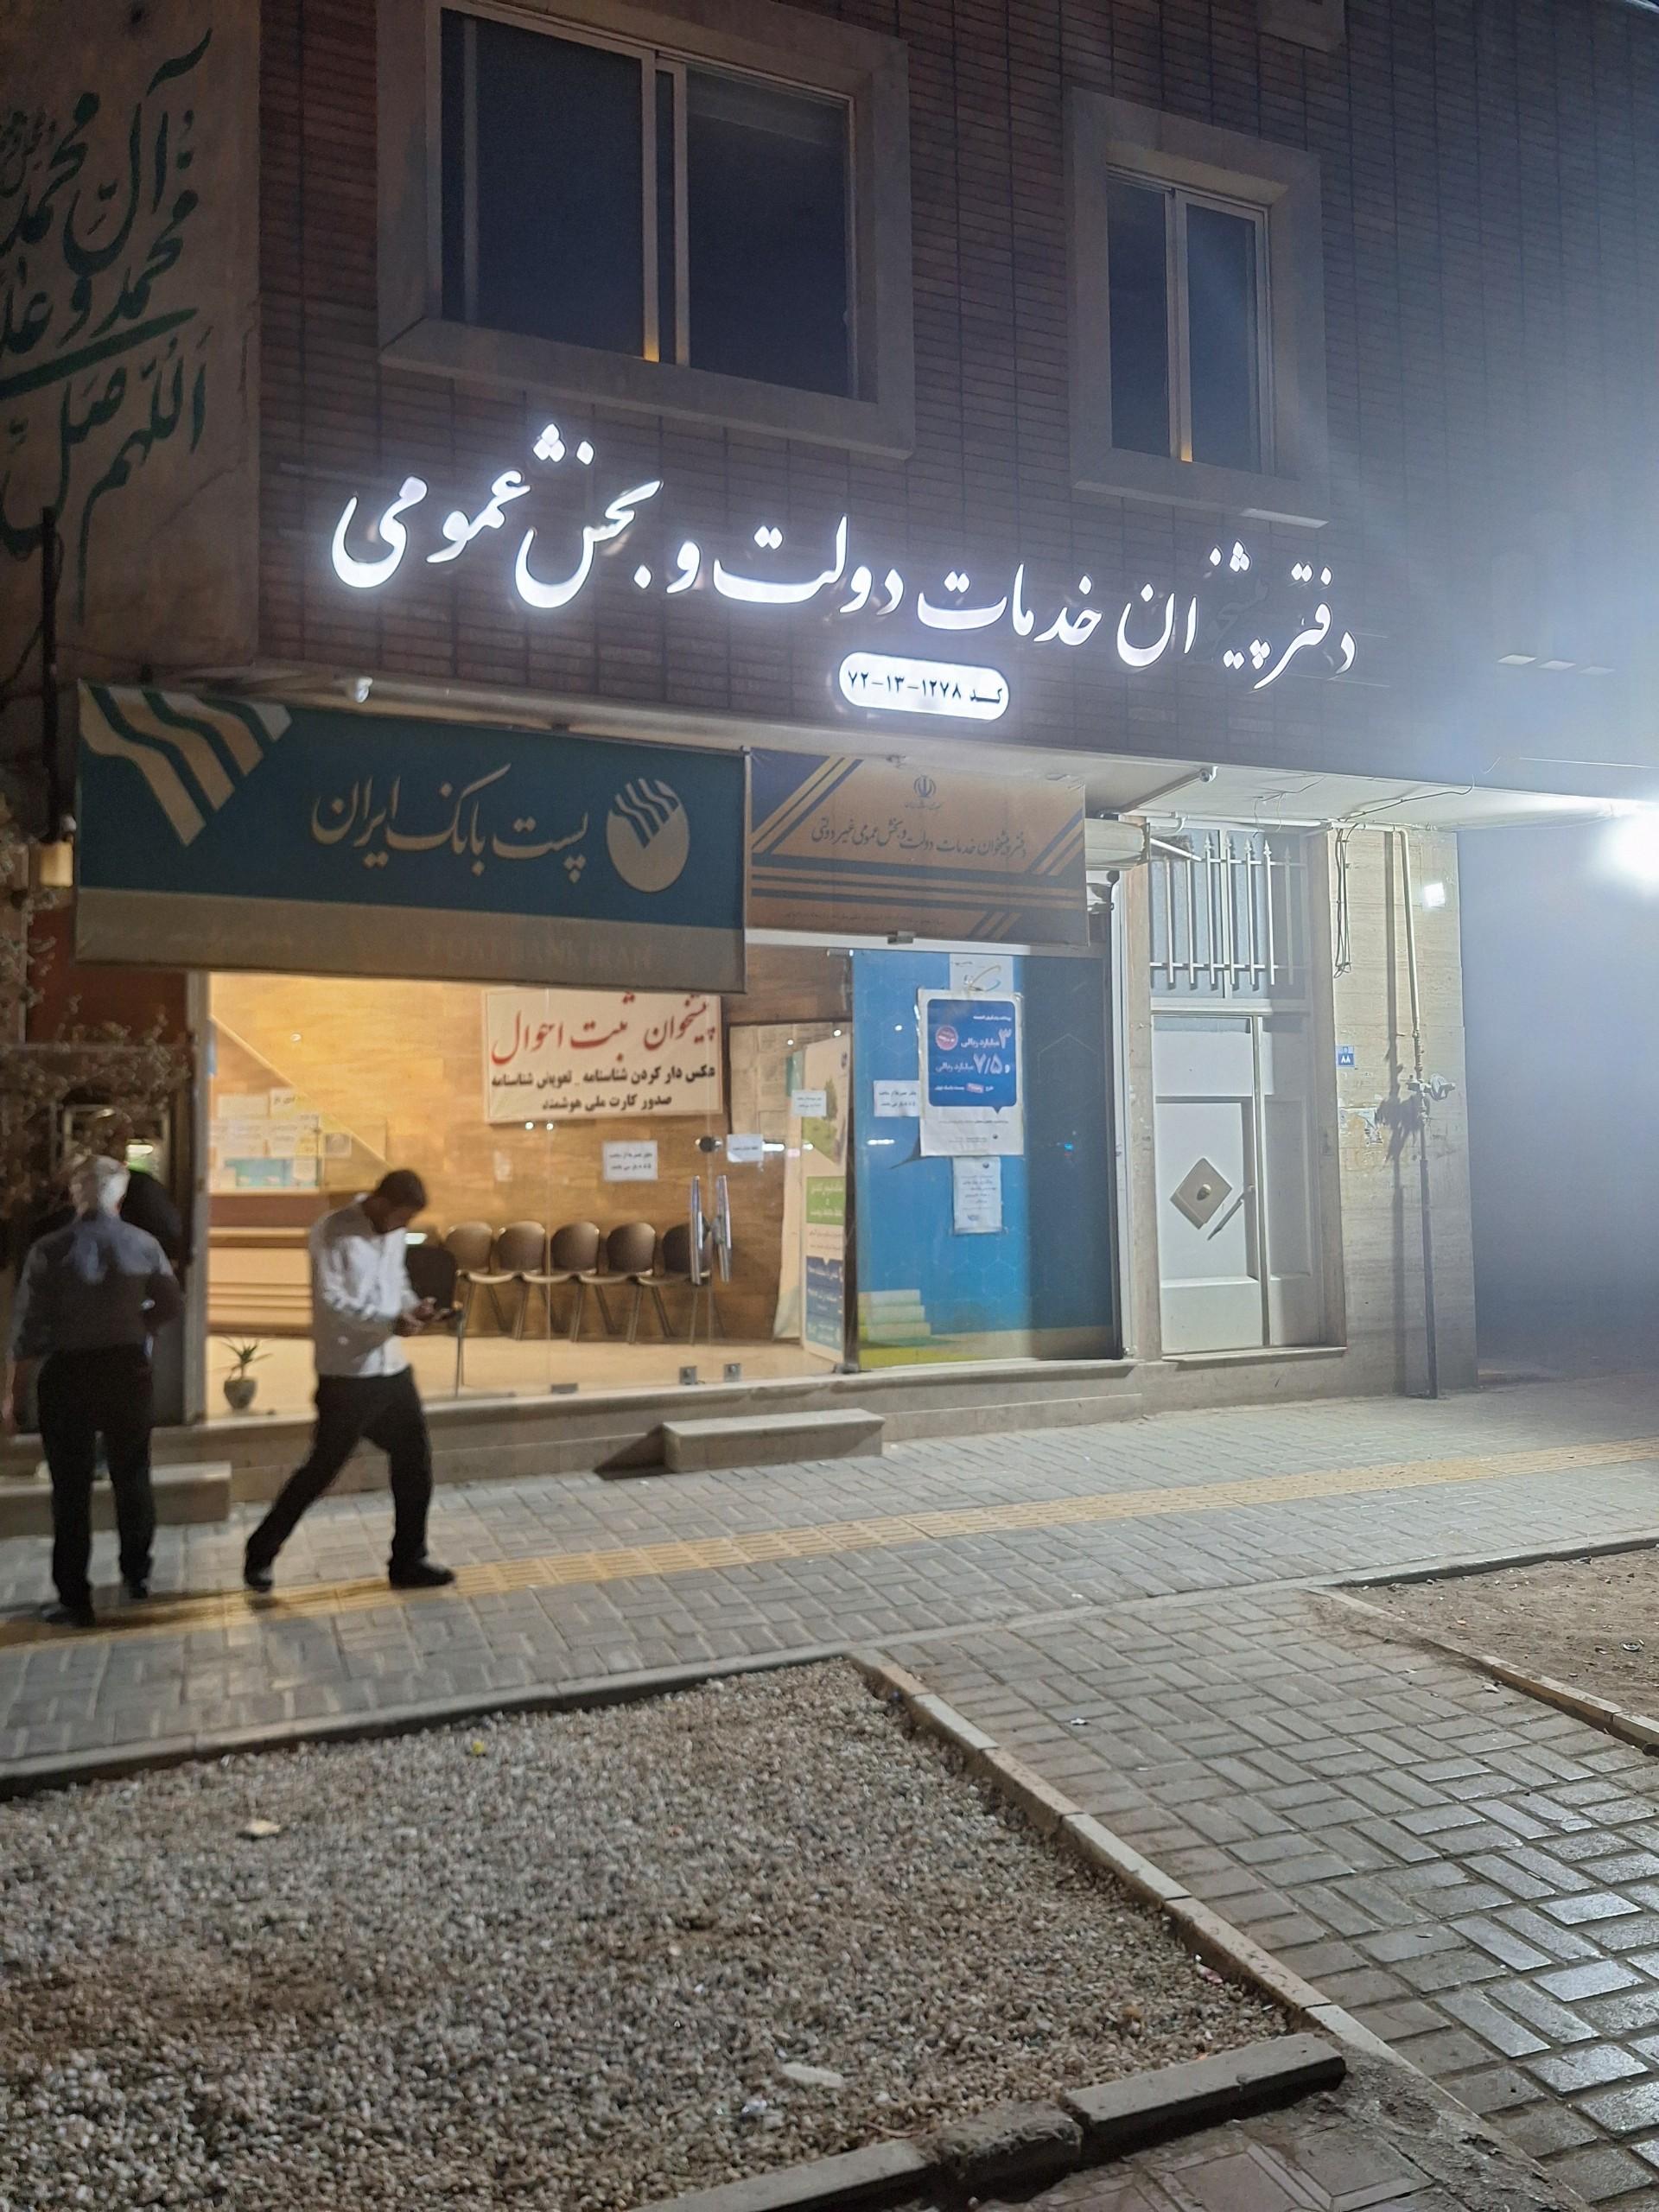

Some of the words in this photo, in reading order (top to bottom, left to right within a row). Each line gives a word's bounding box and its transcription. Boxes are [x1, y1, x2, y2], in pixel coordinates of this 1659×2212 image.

[332, 470, 531, 588] عمومی
[515, 423, 664, 608] بخش
[666, 540, 702, 594] و
[713, 513, 905, 615] دولت
[918, 563, 1103, 646] خدمات
[1253, 562, 1357, 690] دفتر
[969, 687, 1003, 704] کد
[311, 774, 402, 869] ایران
[386, 762, 512, 876] بانک
[492, 810, 588, 884] پست
[491, 1008, 564, 1065] احوال
[570, 990, 635, 1063] ثبت
[998, 1027, 1012, 1050] ۳
[491, 1072, 533, 1086] شناسنامه
[582, 1067, 627, 1084] شناسنامه
[631, 1065, 661, 1085] کردن
[664, 1065, 683, 1084] دار
[542, 1096, 582, 1113] هوشمند
[584, 1095, 606, 1112] ملی
[609, 1093, 638, 1111] کارت
[640, 1095, 672, 1110] صدور
